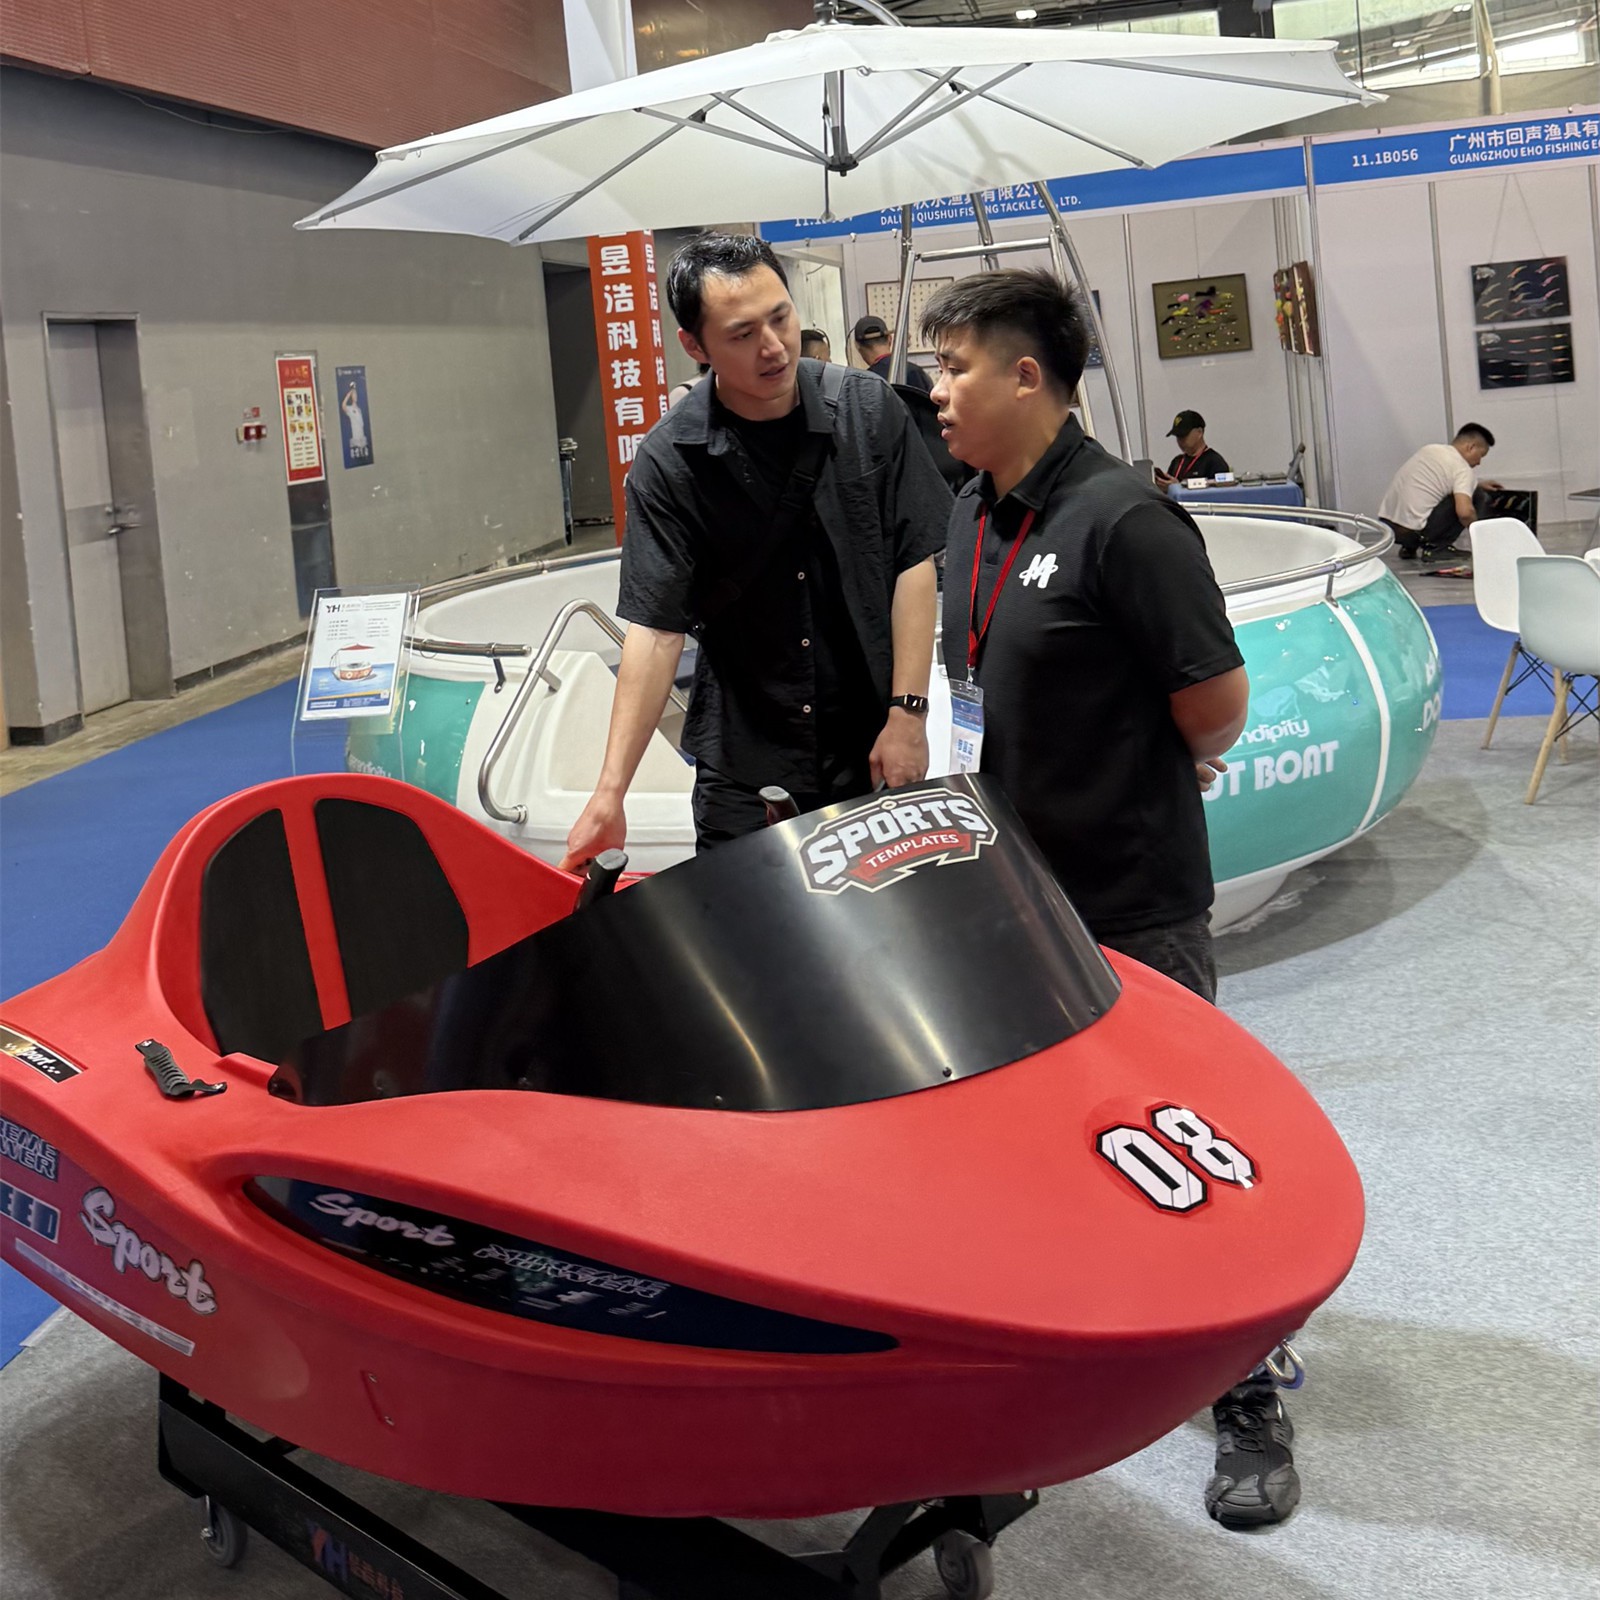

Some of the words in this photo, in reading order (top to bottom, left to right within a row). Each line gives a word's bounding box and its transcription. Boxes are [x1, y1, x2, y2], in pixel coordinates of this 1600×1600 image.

[1449, 119, 1600, 151] 广州市回声渔具有
[1449, 147, 1518, 165] GUANGZHOU
[1520, 143, 1544, 158] EHO
[1545, 140, 1590, 155] FISHING
[1352, 149, 1419, 168] 11.1B056
[916, 208, 958, 223] QIUSHUI
[960, 204, 1000, 218] FISNG
[1001, 200, 1036, 213] TACKLE
[1060, 195, 1081, 207] LTD.
[1254, 741, 1339, 790] BOAT
[807, 800, 989, 885] SPORTS
[866, 833, 960, 868] TEMPLATES
[1096, 1104, 1257, 1213] 08
[309, 1193, 456, 1246] Sport
[79, 1186, 218, 1315] Sport
